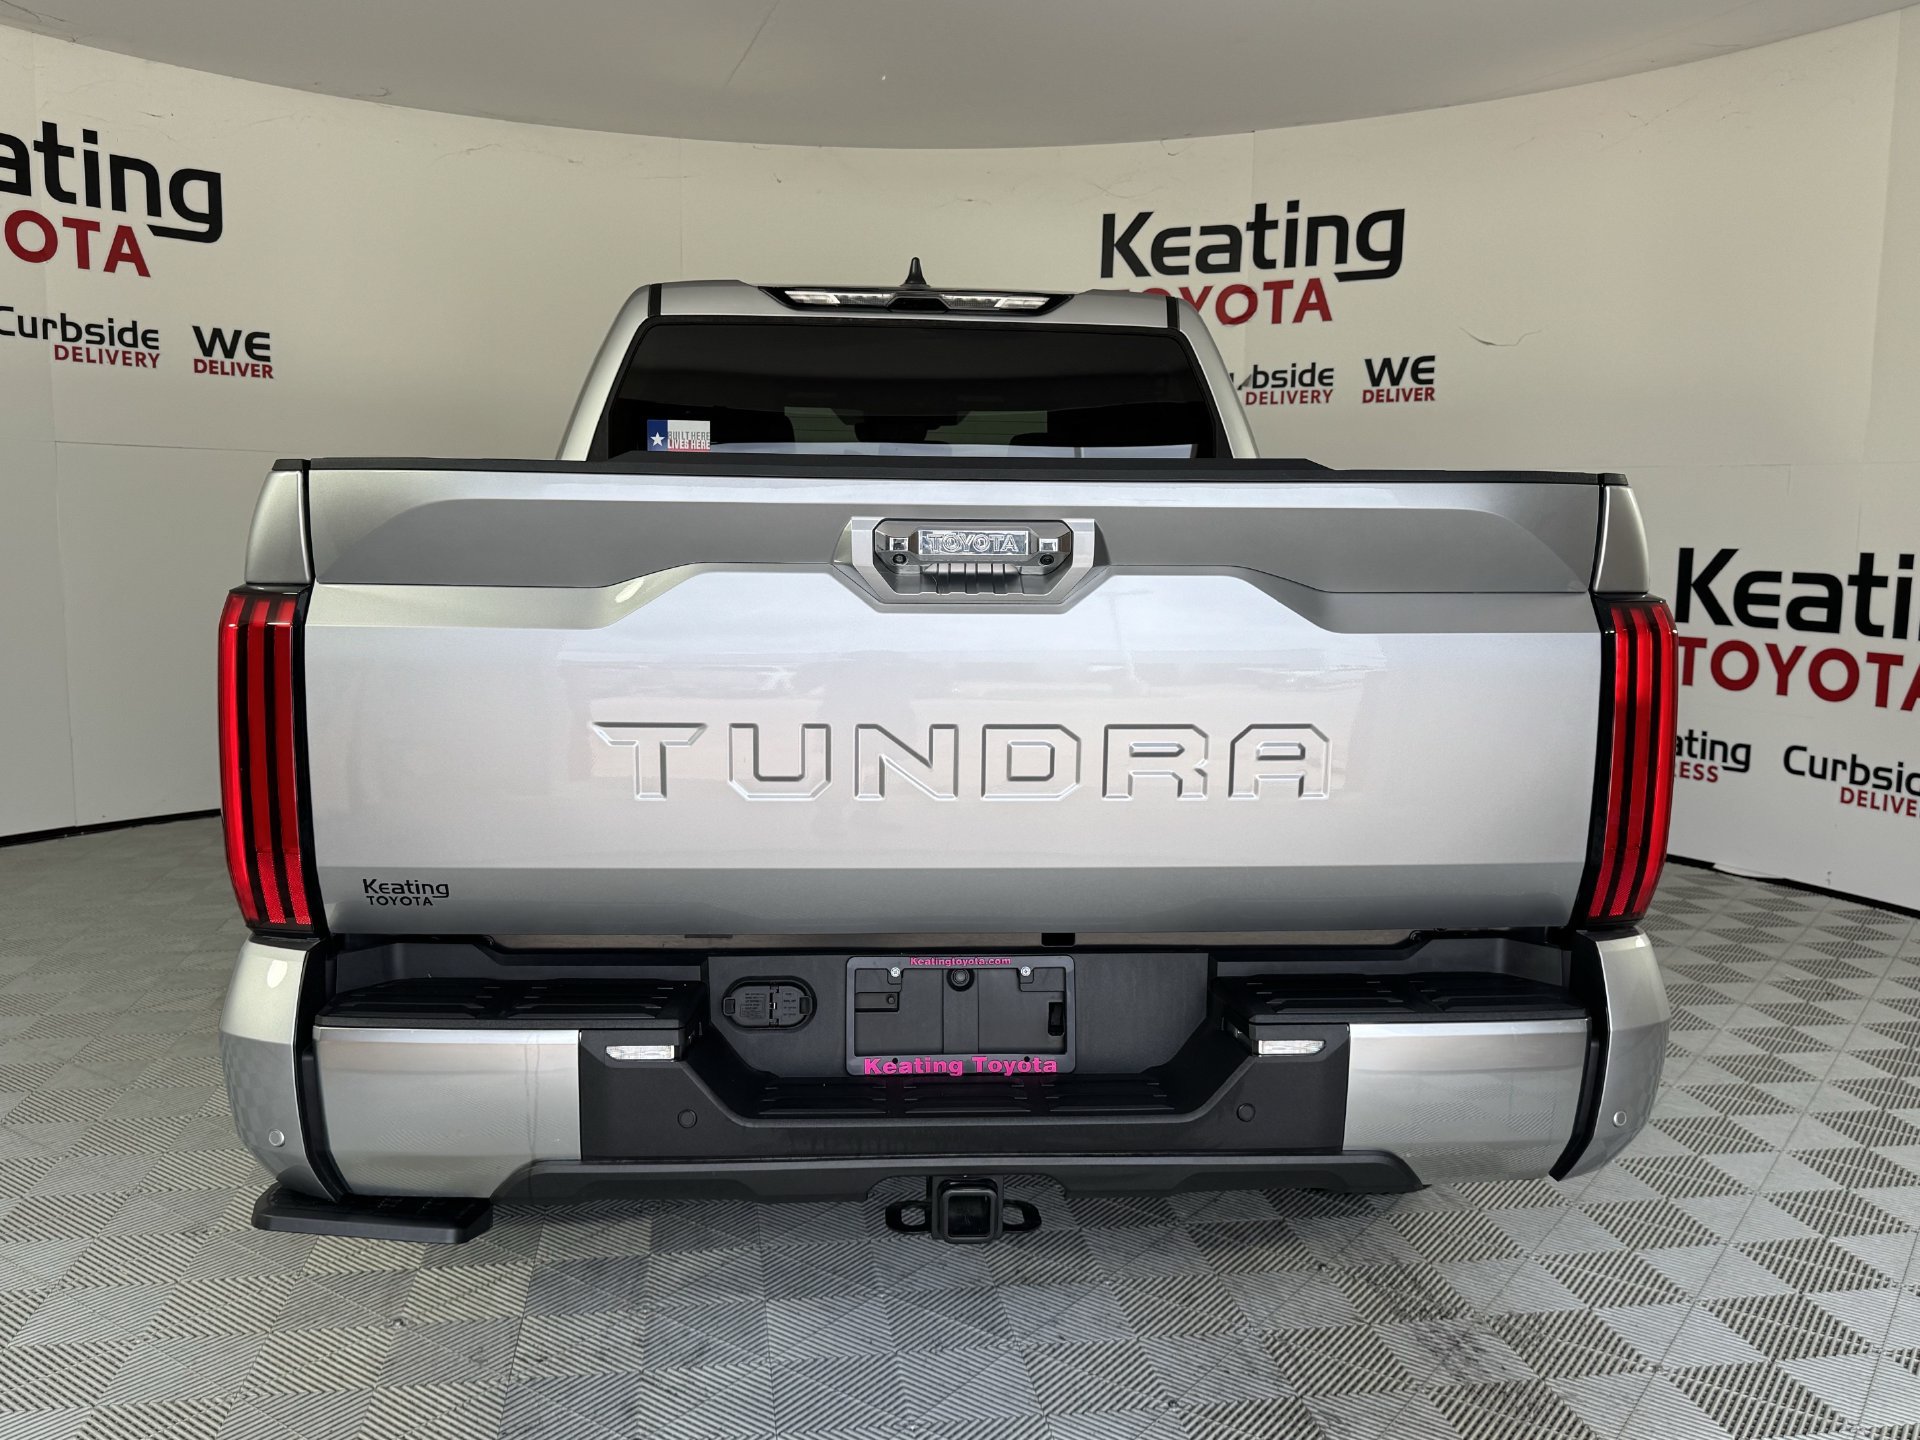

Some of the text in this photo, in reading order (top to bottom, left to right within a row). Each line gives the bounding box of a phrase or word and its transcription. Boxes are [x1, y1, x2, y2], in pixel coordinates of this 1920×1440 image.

[4, 209, 151, 278] OTA
[1100, 200, 1405, 282] Keating
[1120, 278, 1333, 326] YOTA
[192, 325, 271, 362] WE
[54, 344, 160, 368] DELIVERY
[193, 358, 274, 379] DELIVER
[1364, 355, 1436, 387] WE
[1245, 389, 1334, 405] DELIVERY
[1362, 387, 1435, 403] DELIVER
[668, 431, 710, 440] BUILT HERE
[668, 440, 710, 450] LIVES HERE
[927, 532, 1020, 553] TOYOTA
[1674, 547, 1920, 641] Keati
[590, 721, 1330, 802] TUNDRA
[1675, 761, 1719, 784] ESS
[1840, 786, 1920, 818] DELIVE
[362, 878, 450, 899] Keating
[366, 895, 433, 906] TOYOTA
[863, 1056, 1057, 1077] Keating Toyota
